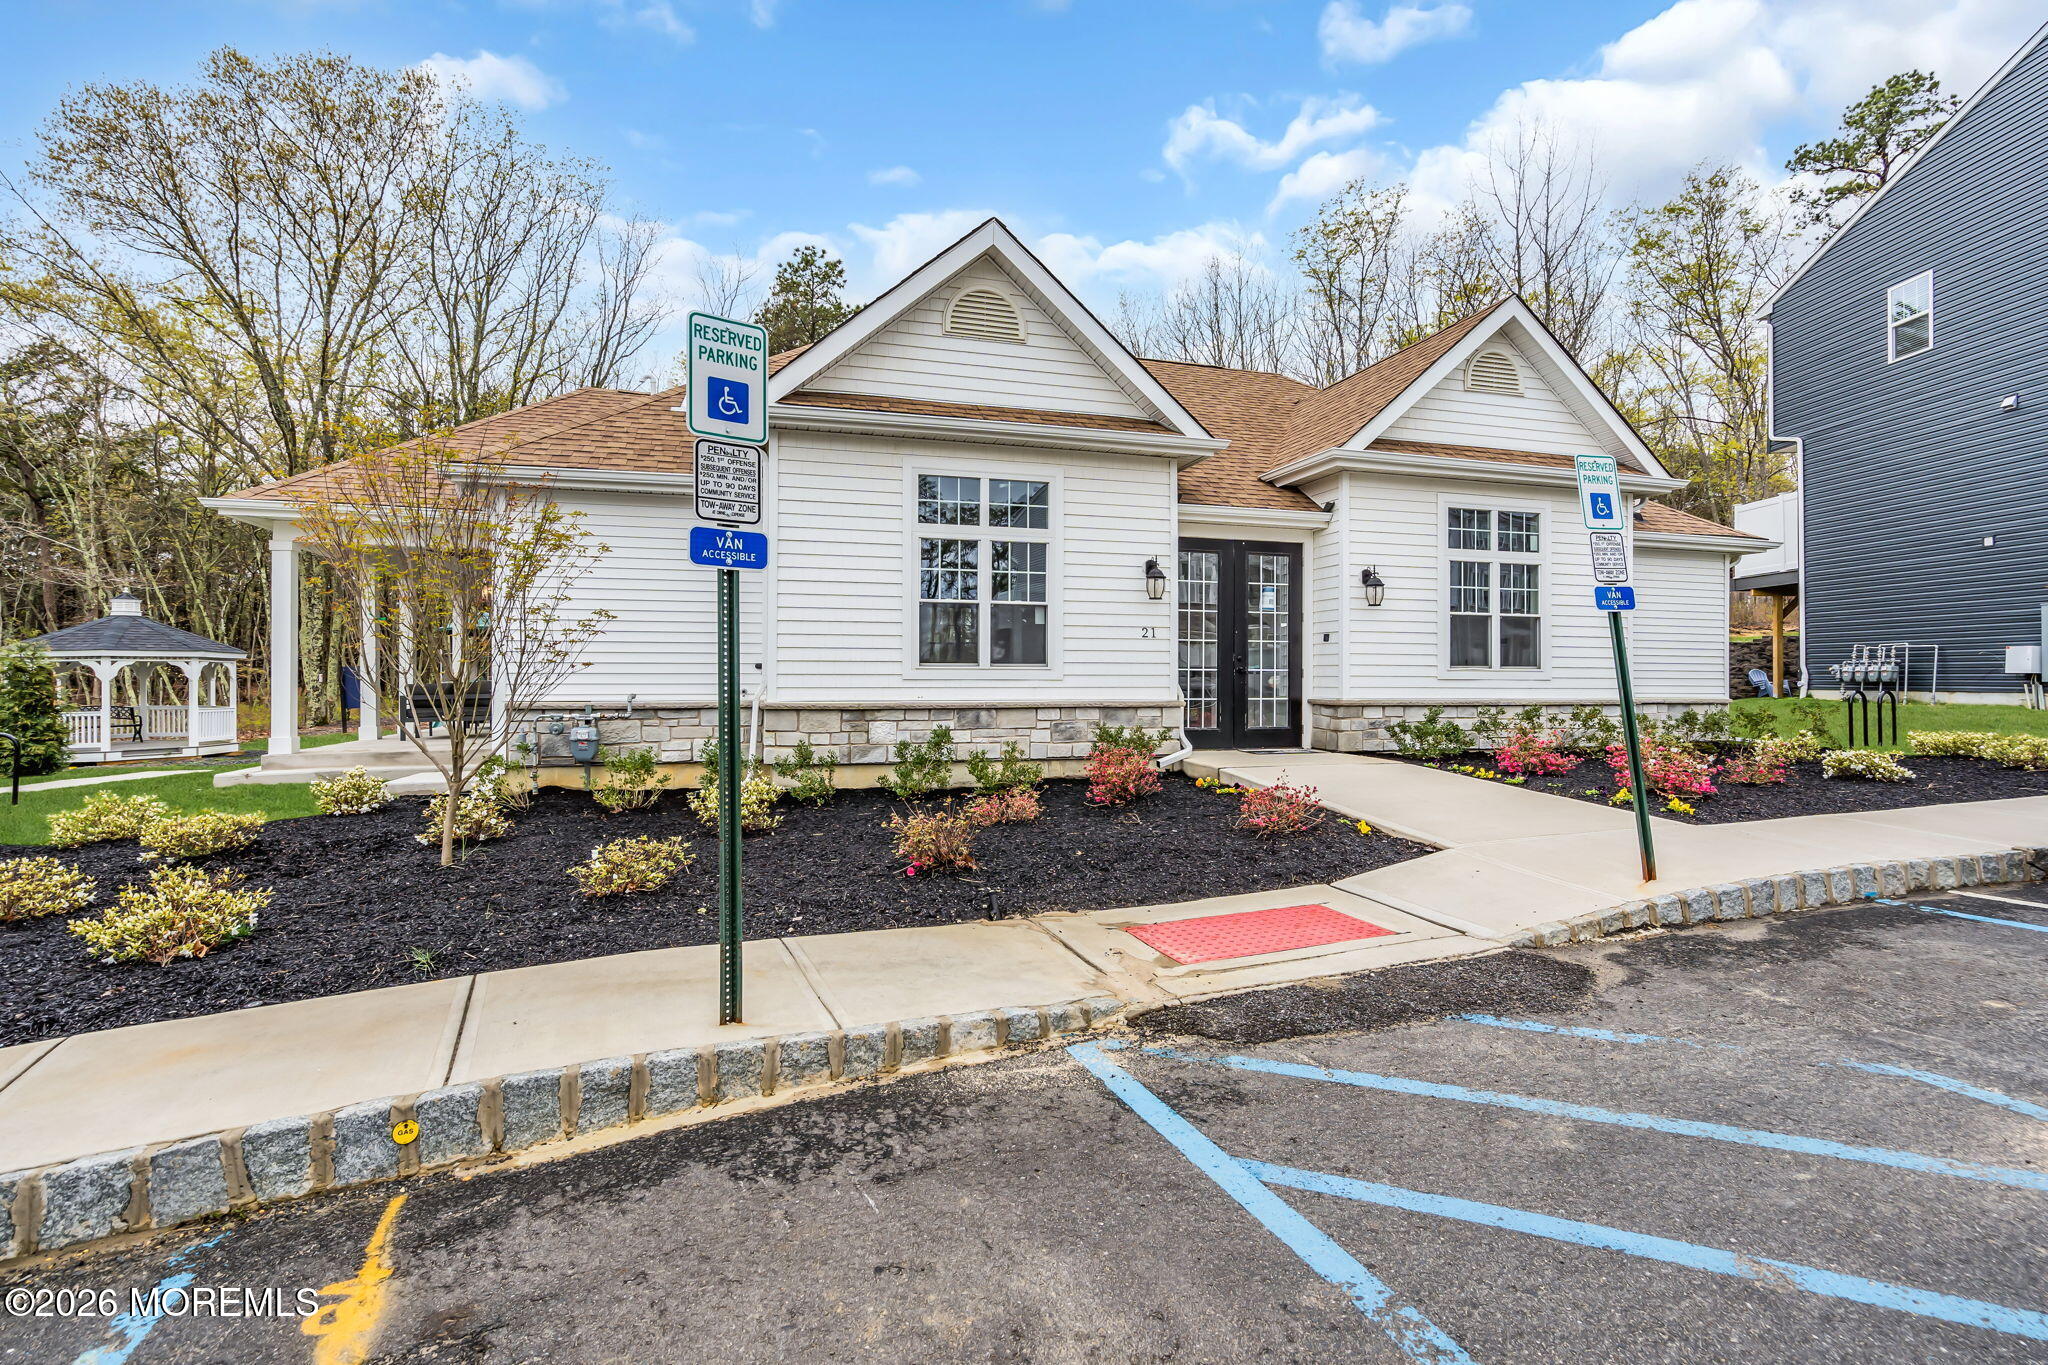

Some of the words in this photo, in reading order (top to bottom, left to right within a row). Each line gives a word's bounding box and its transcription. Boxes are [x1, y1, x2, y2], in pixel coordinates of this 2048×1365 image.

[694, 323, 761, 351] RESERVED
[698, 345, 758, 371] PARKING
[708, 445, 748, 458] PENLTY
[727, 458, 756, 468] OFFENSE
[1579, 462, 1614, 472] RESERVED
[700, 463, 731, 472] SUBSEQUENT
[732, 467, 756, 477] OFFENSES
[732, 476, 757, 484] AND/OR
[1582, 474, 1614, 485] PARKING
[700, 488, 733, 498] COMMUNITY
[734, 492, 756, 500] SERVICE
[738, 484, 756, 492] DAYS
[700, 500, 736, 511] TOW-AWAY
[738, 504, 757, 514] ZONE
[716, 536, 744, 550] VAN
[702, 550, 756, 562] ACCESSIBLE
[1142, 627, 1156, 638] 21
